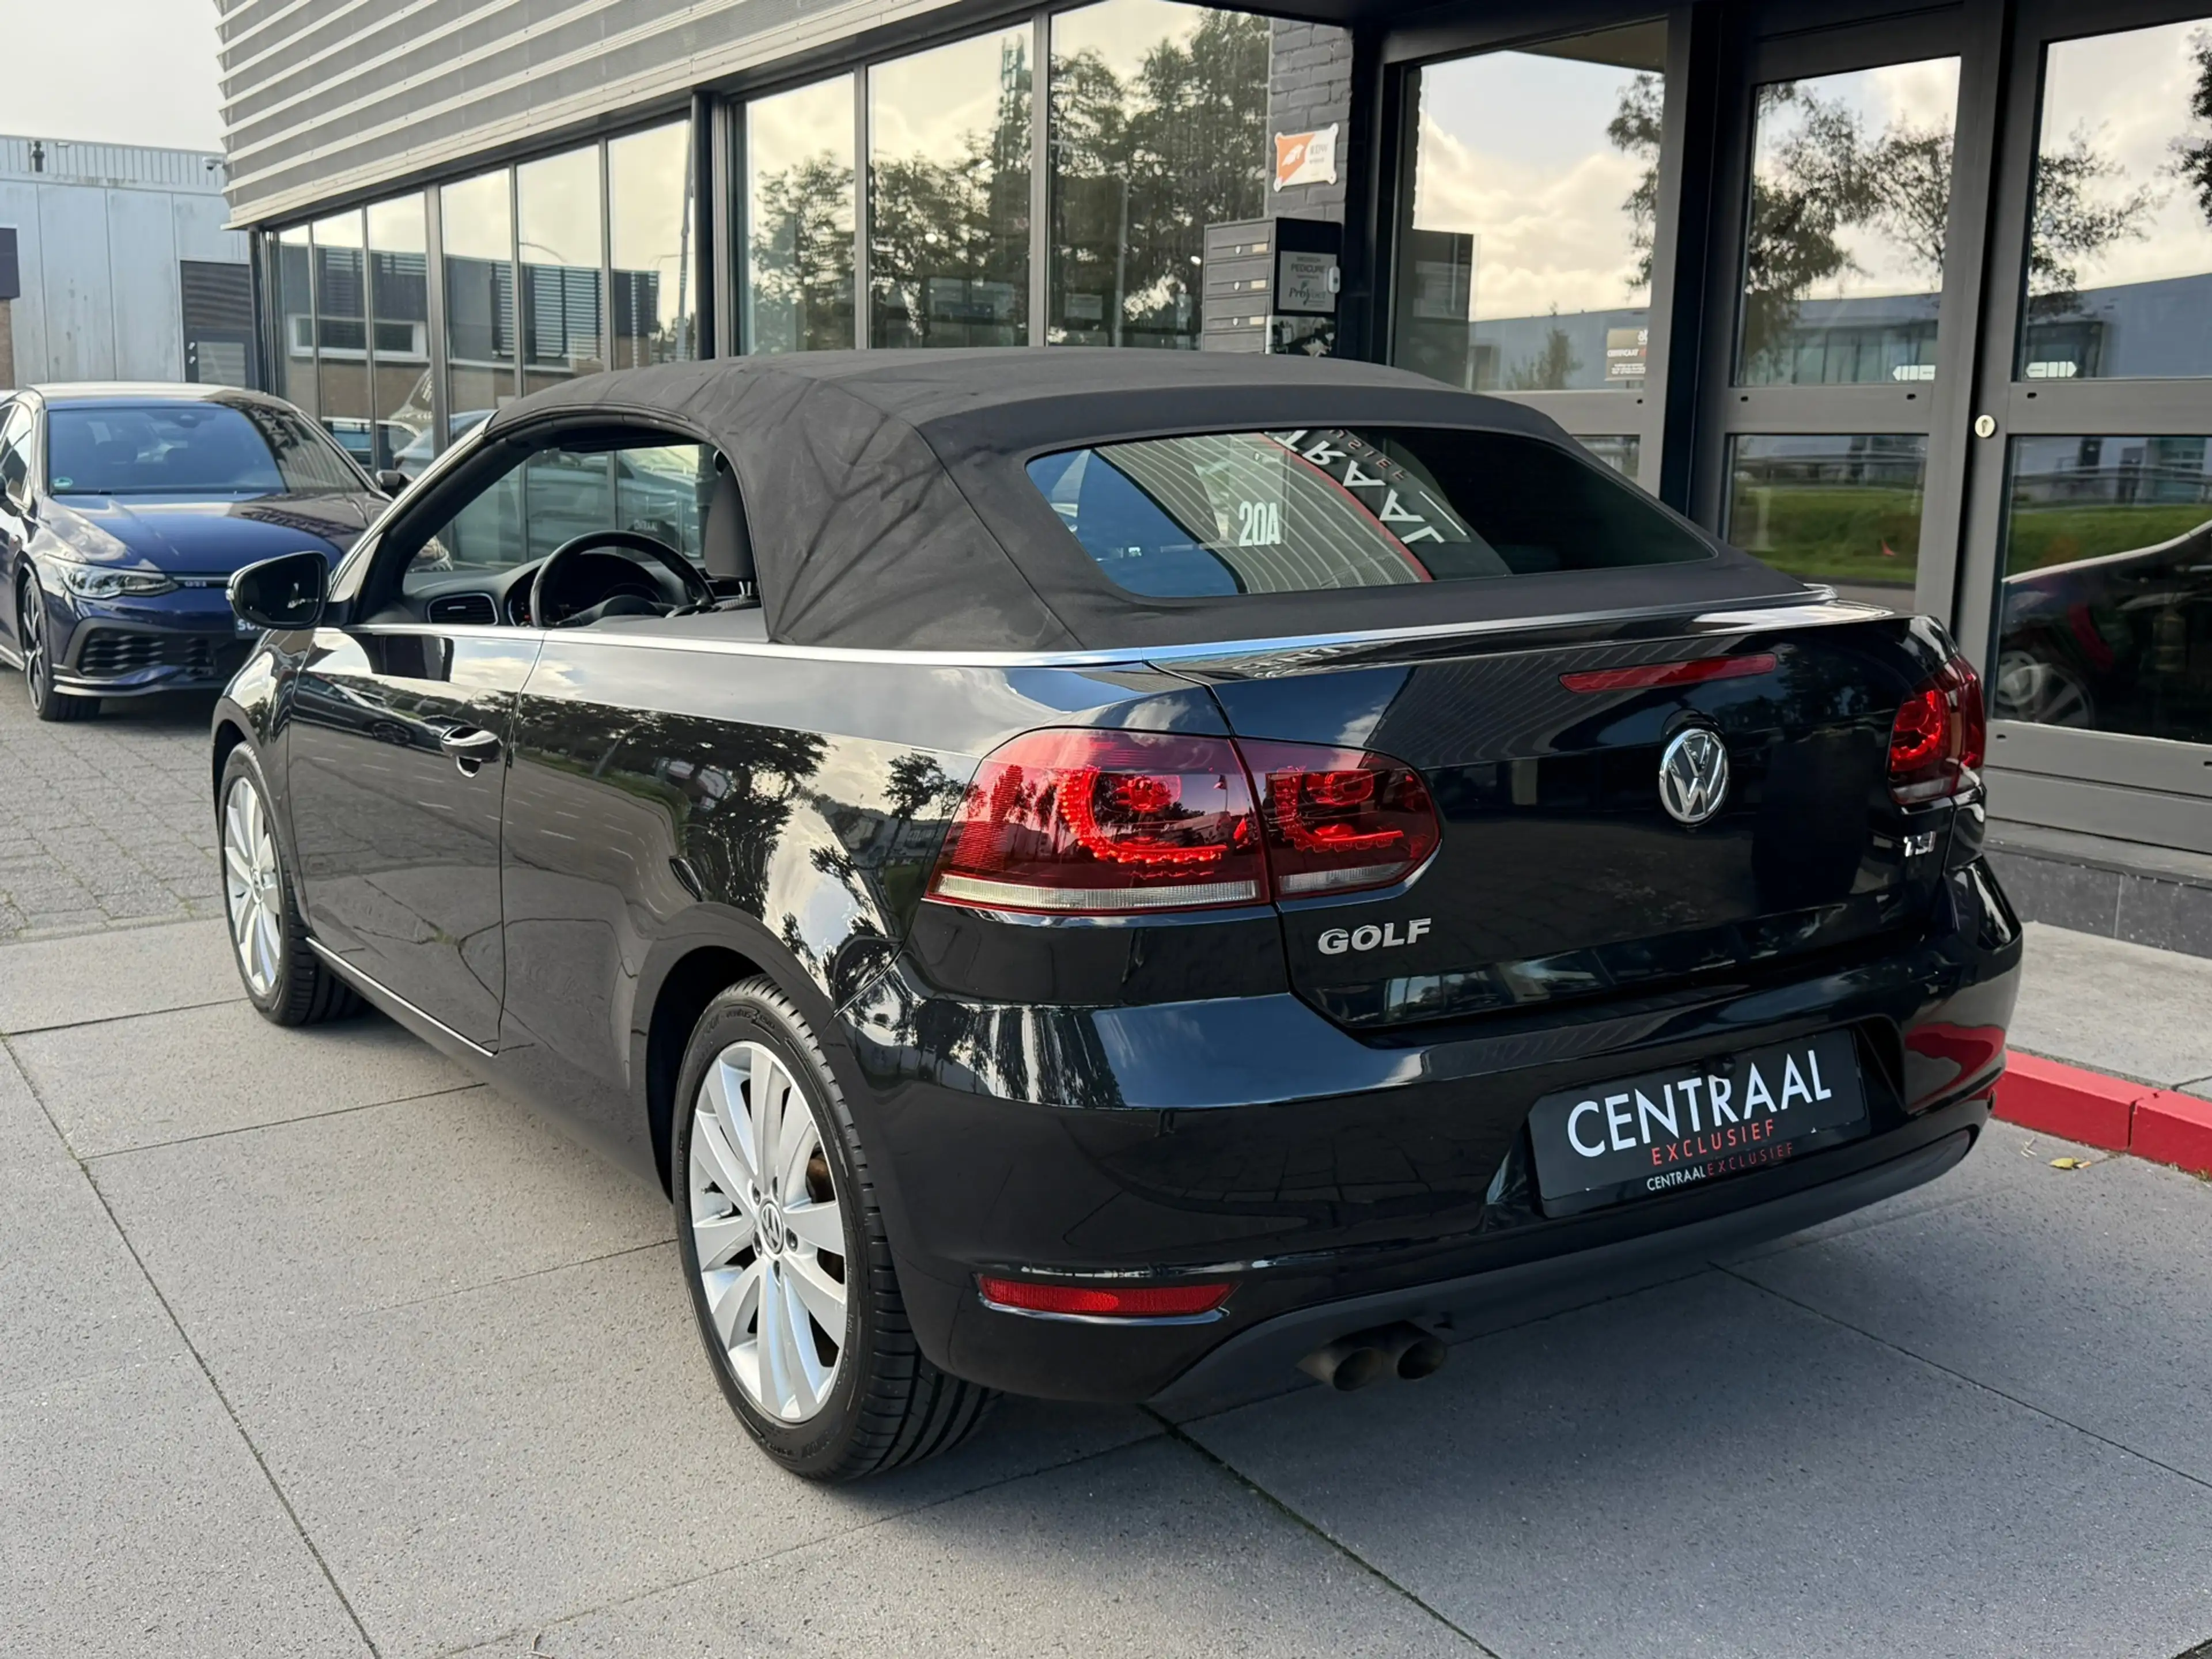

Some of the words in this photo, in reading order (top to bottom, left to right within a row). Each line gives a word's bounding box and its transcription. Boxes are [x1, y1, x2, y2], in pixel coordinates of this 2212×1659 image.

[1238, 501, 1282, 548] 20A
[1317, 918, 1431, 955] GOLF
[1567, 1050, 1832, 1158] CENTRAAL
[1651, 1119, 1775, 1166] EXCLUSIEF
